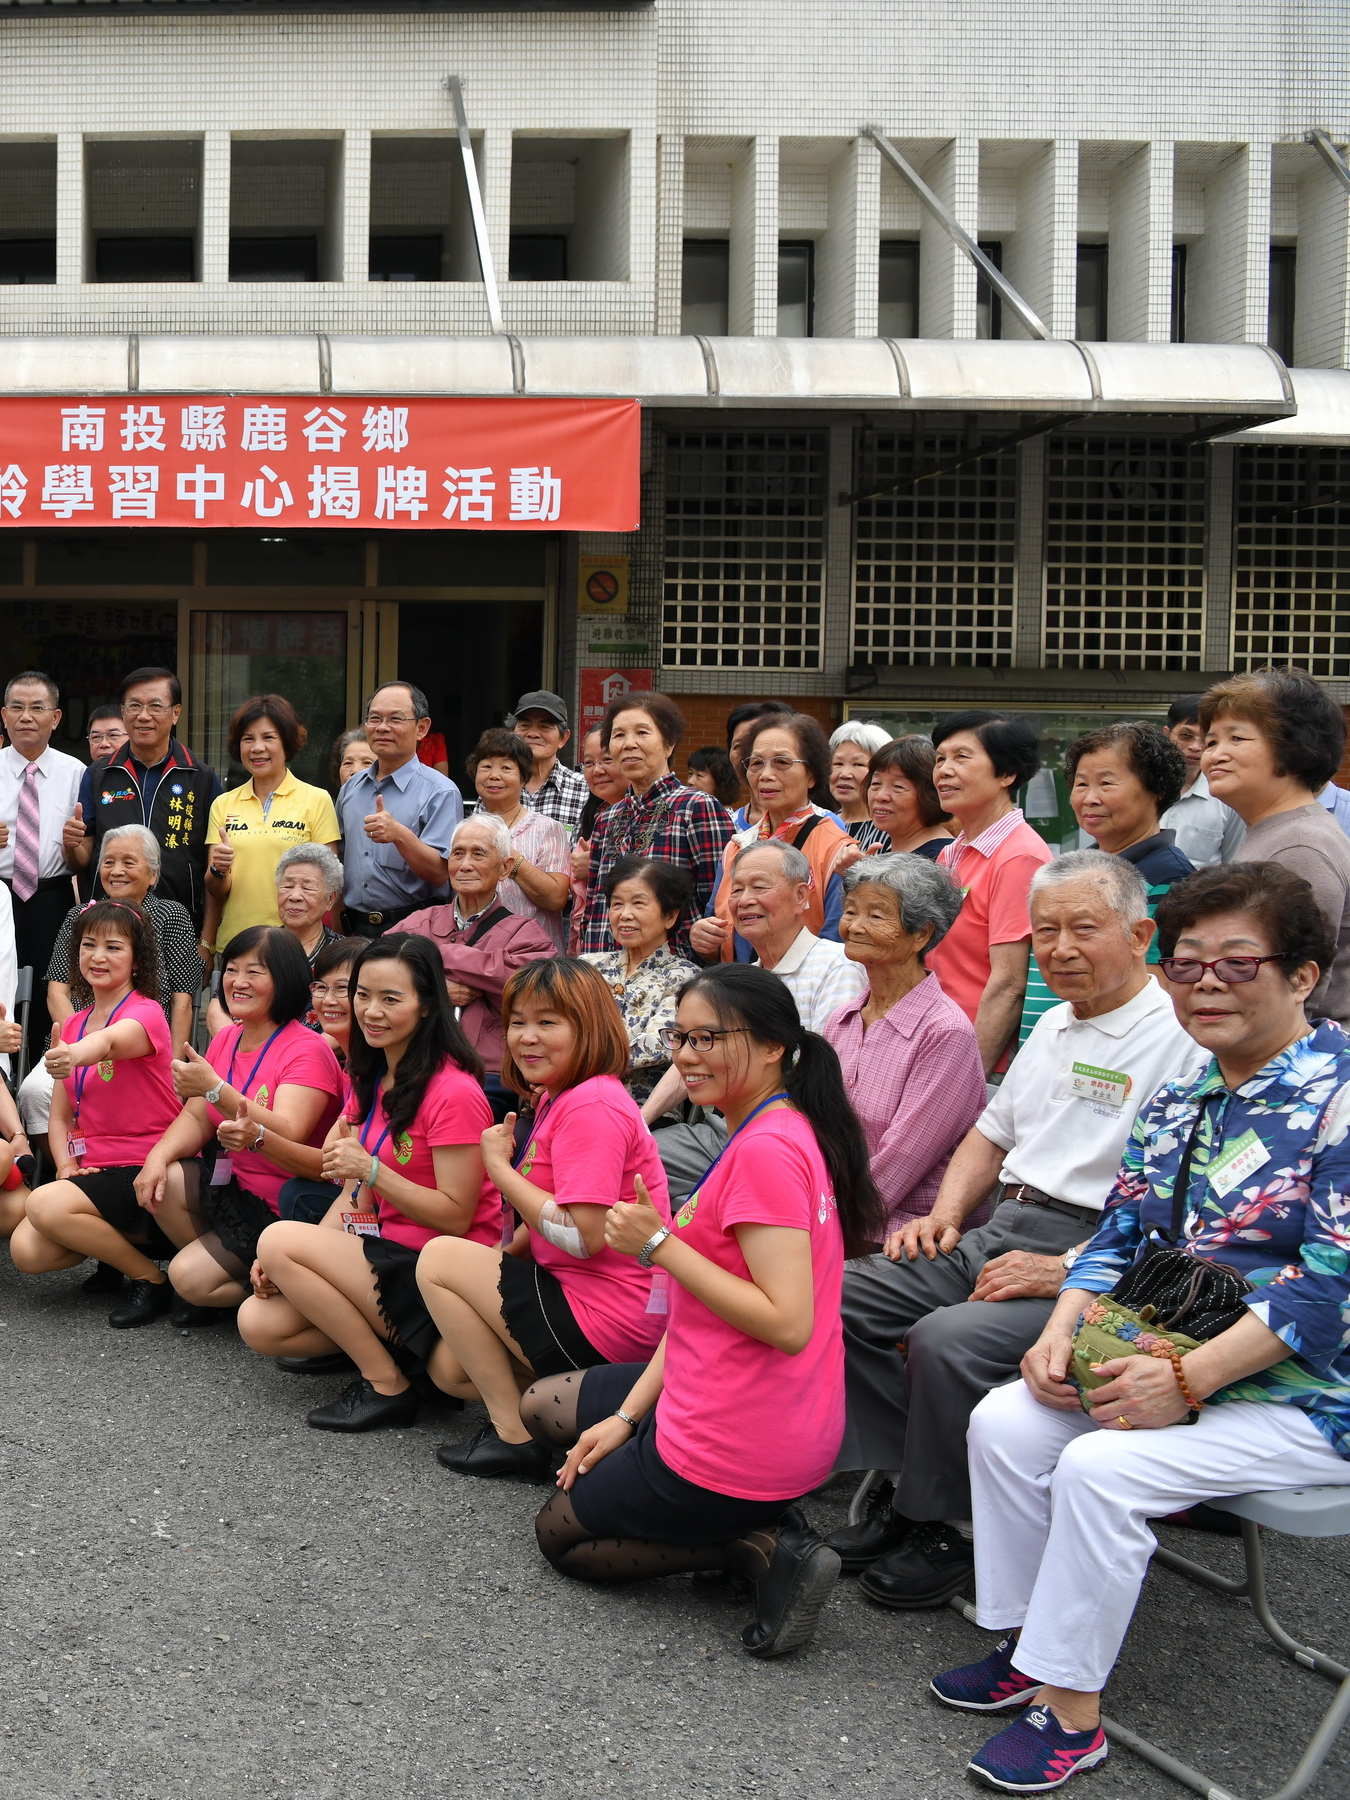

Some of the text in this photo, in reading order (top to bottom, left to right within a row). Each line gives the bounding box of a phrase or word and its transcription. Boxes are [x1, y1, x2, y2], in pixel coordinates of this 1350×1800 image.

[60, 405, 410, 453] 南投縣鹿谷鄉
[583, 705, 608, 716] 避難
[165, 797, 185, 849] 林明溱
[182, 790, 195, 846] 南投縣長
[225, 822, 248, 833] FILA
